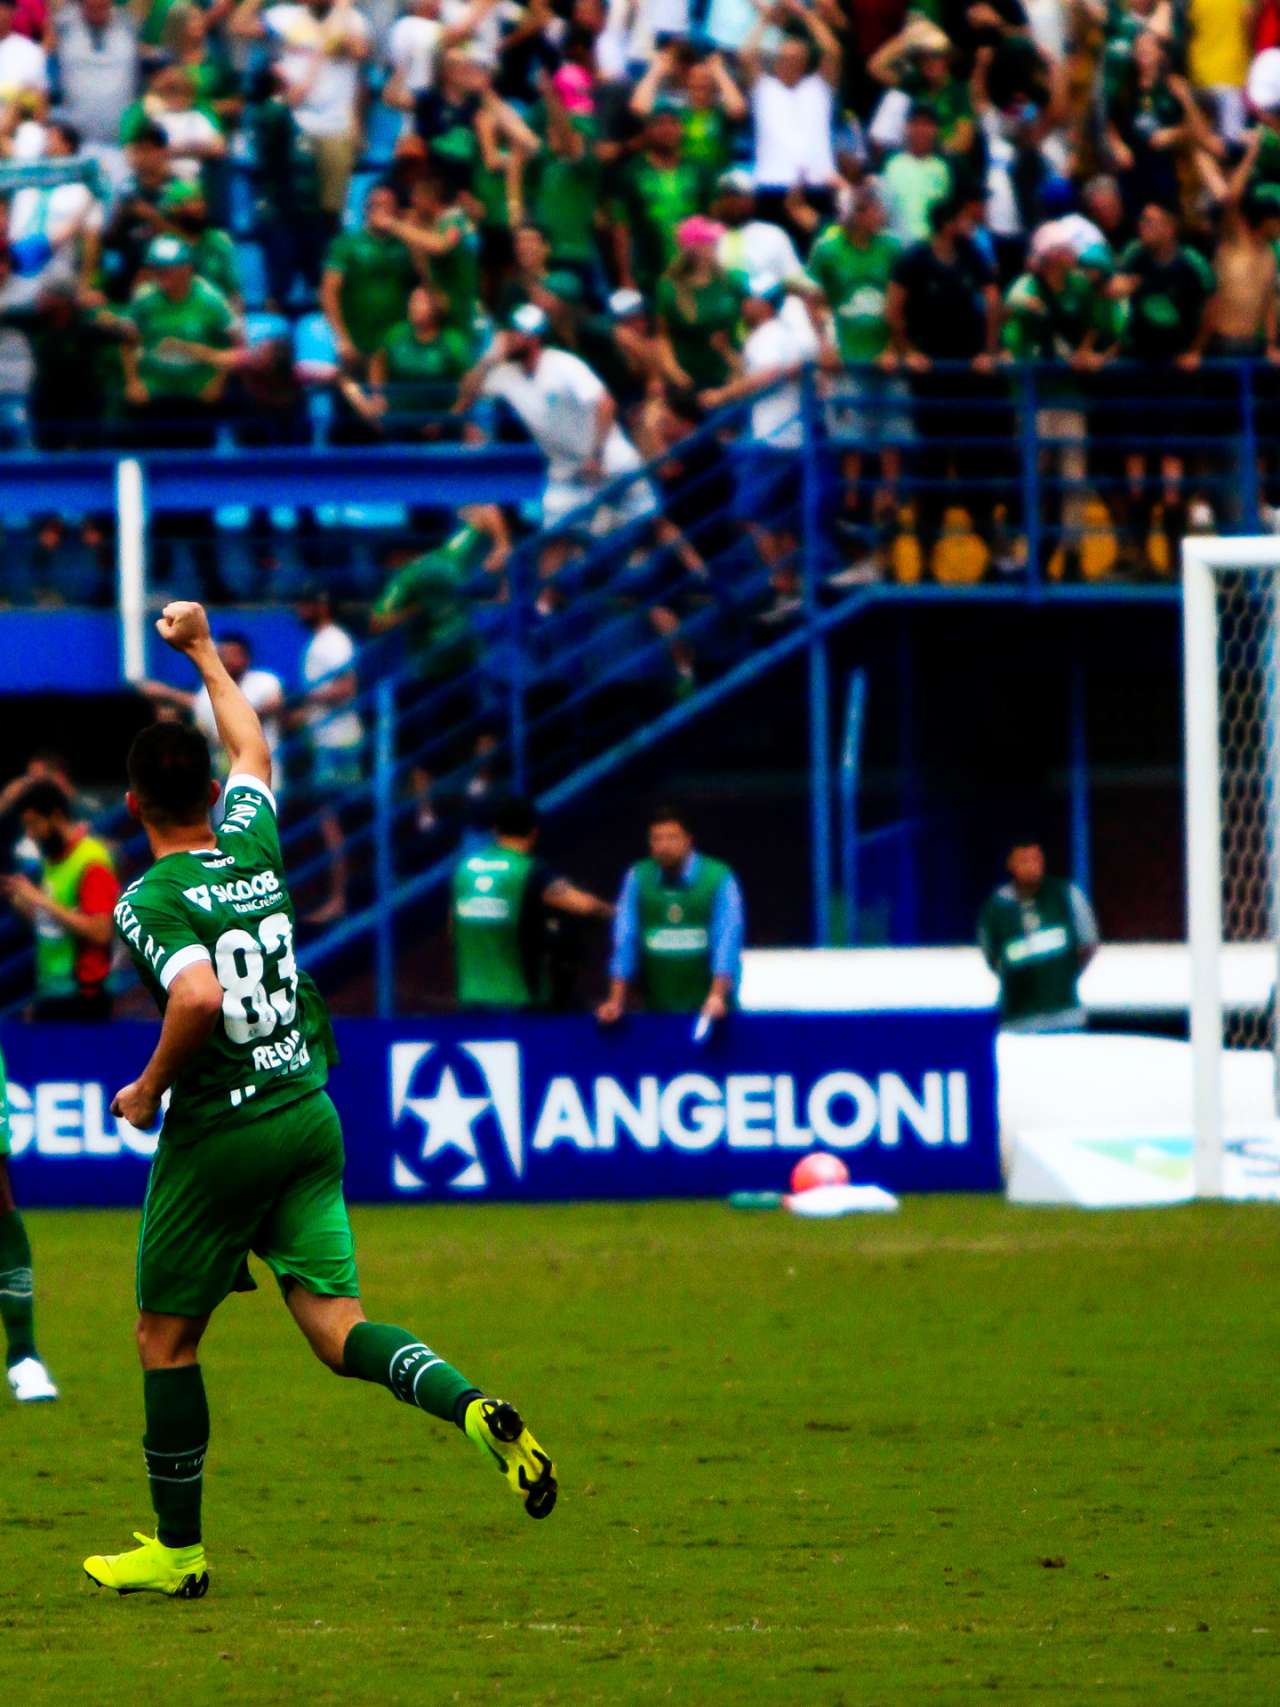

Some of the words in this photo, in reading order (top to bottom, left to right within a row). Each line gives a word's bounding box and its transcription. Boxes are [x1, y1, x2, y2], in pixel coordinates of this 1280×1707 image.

[210, 870, 279, 902] SICOOB
[215, 912, 299, 1044] 83
[532, 1071, 969, 1149] ANGELONI
